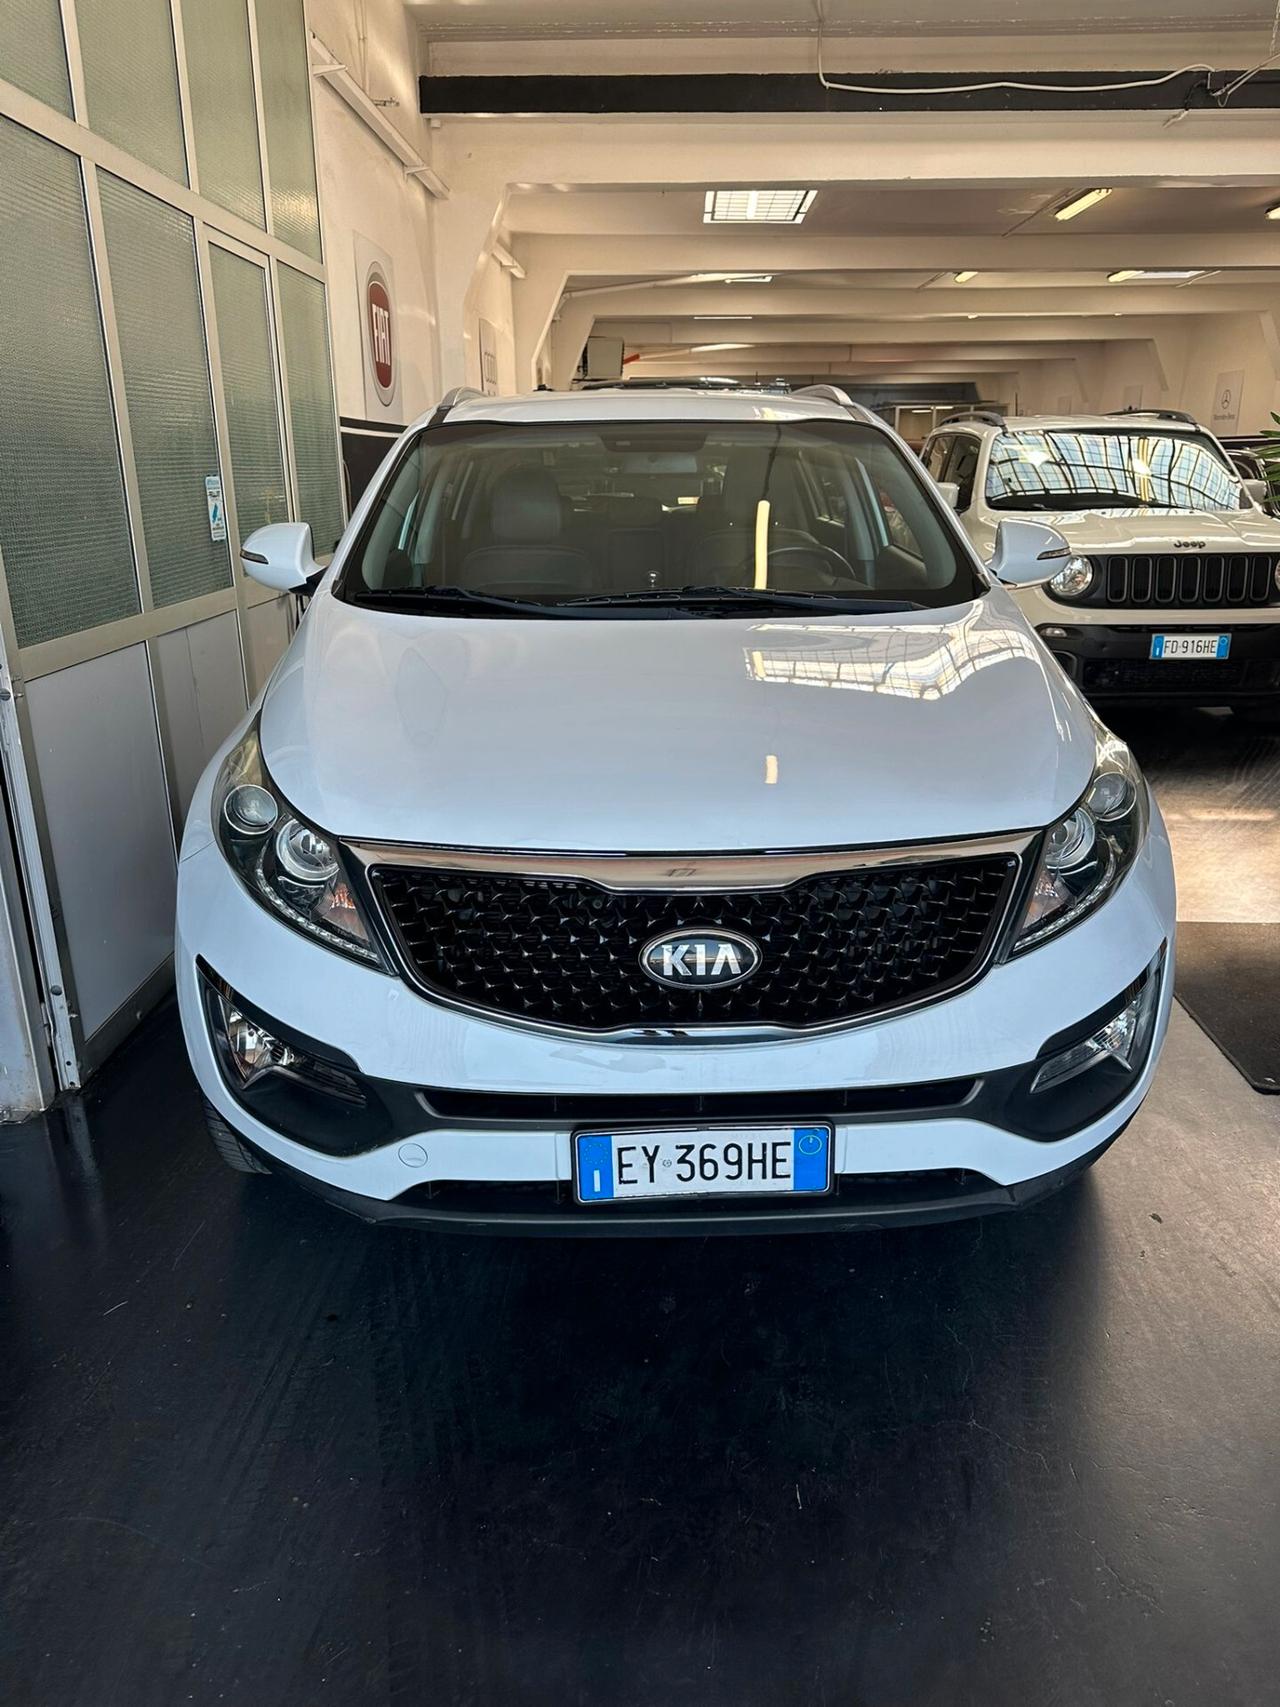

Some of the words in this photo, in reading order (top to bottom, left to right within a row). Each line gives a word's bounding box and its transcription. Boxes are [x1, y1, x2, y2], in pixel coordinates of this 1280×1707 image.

[371, 303, 391, 366] FIAT
[1173, 539, 1206, 549] Jeep
[1164, 640, 1179, 654] FD
[1181, 639, 1218, 654] 916HE
[661, 943, 742, 976] KIA
[616, 1144, 661, 1185] EY
[675, 1141, 792, 1182] 369HE
